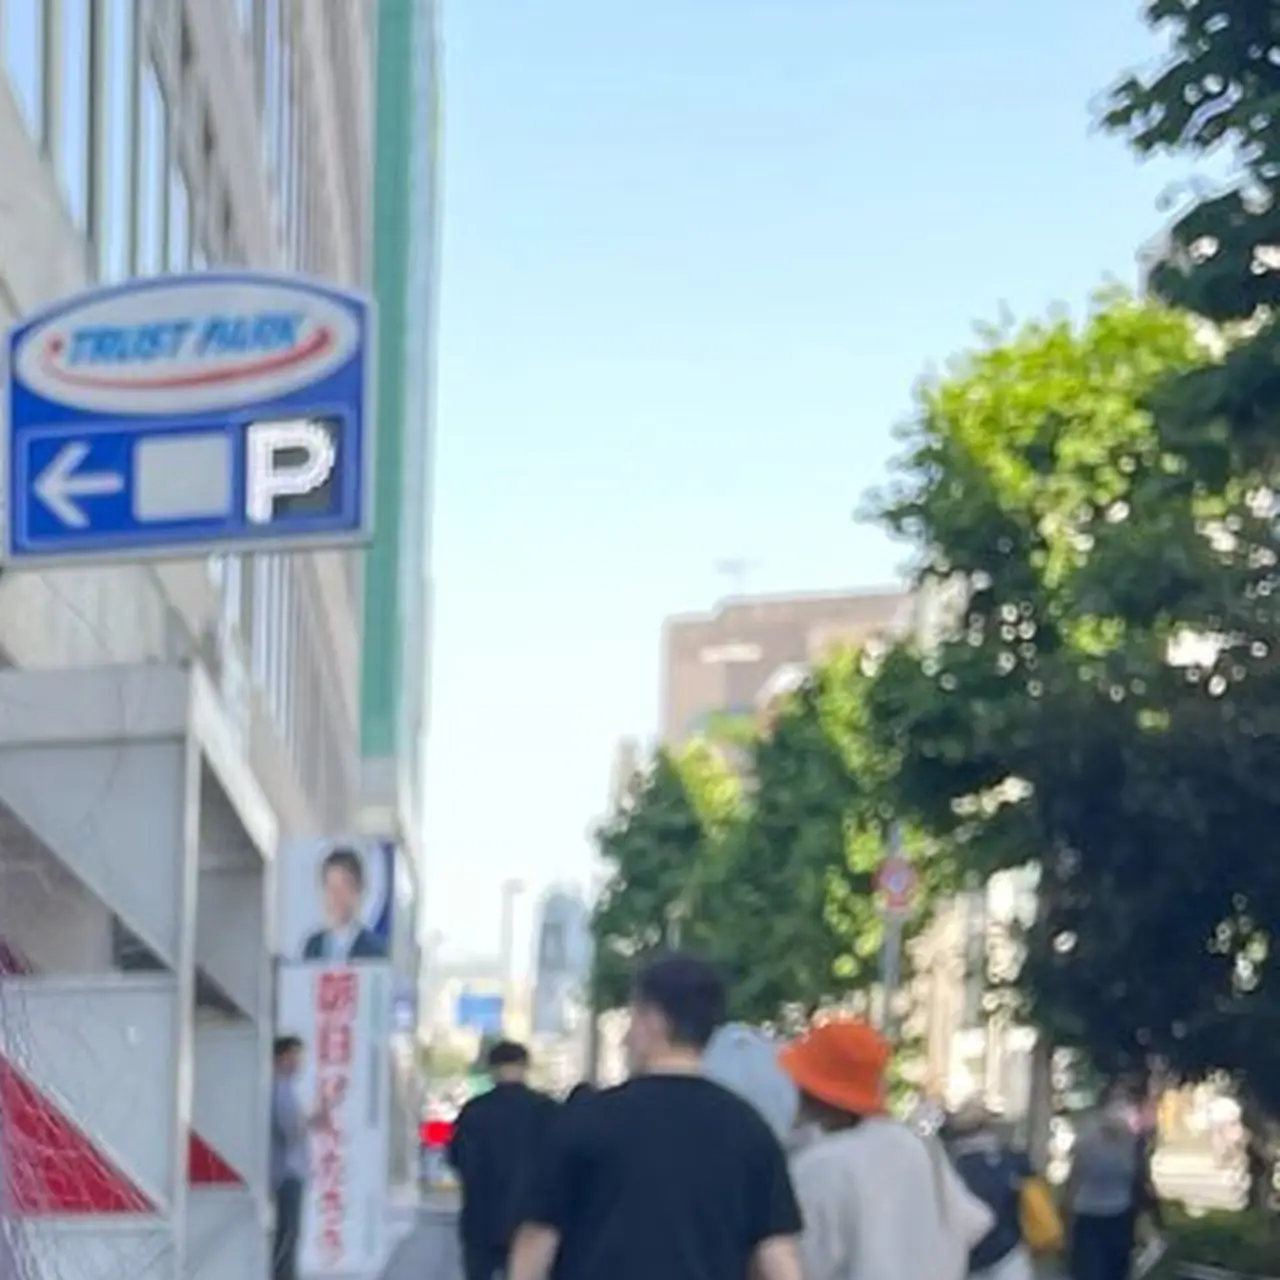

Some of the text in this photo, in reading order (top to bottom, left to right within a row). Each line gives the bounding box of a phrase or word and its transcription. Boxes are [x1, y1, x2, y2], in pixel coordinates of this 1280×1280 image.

[68, 310, 307, 366] TRUST PARK
[246, 419, 335, 523] P
